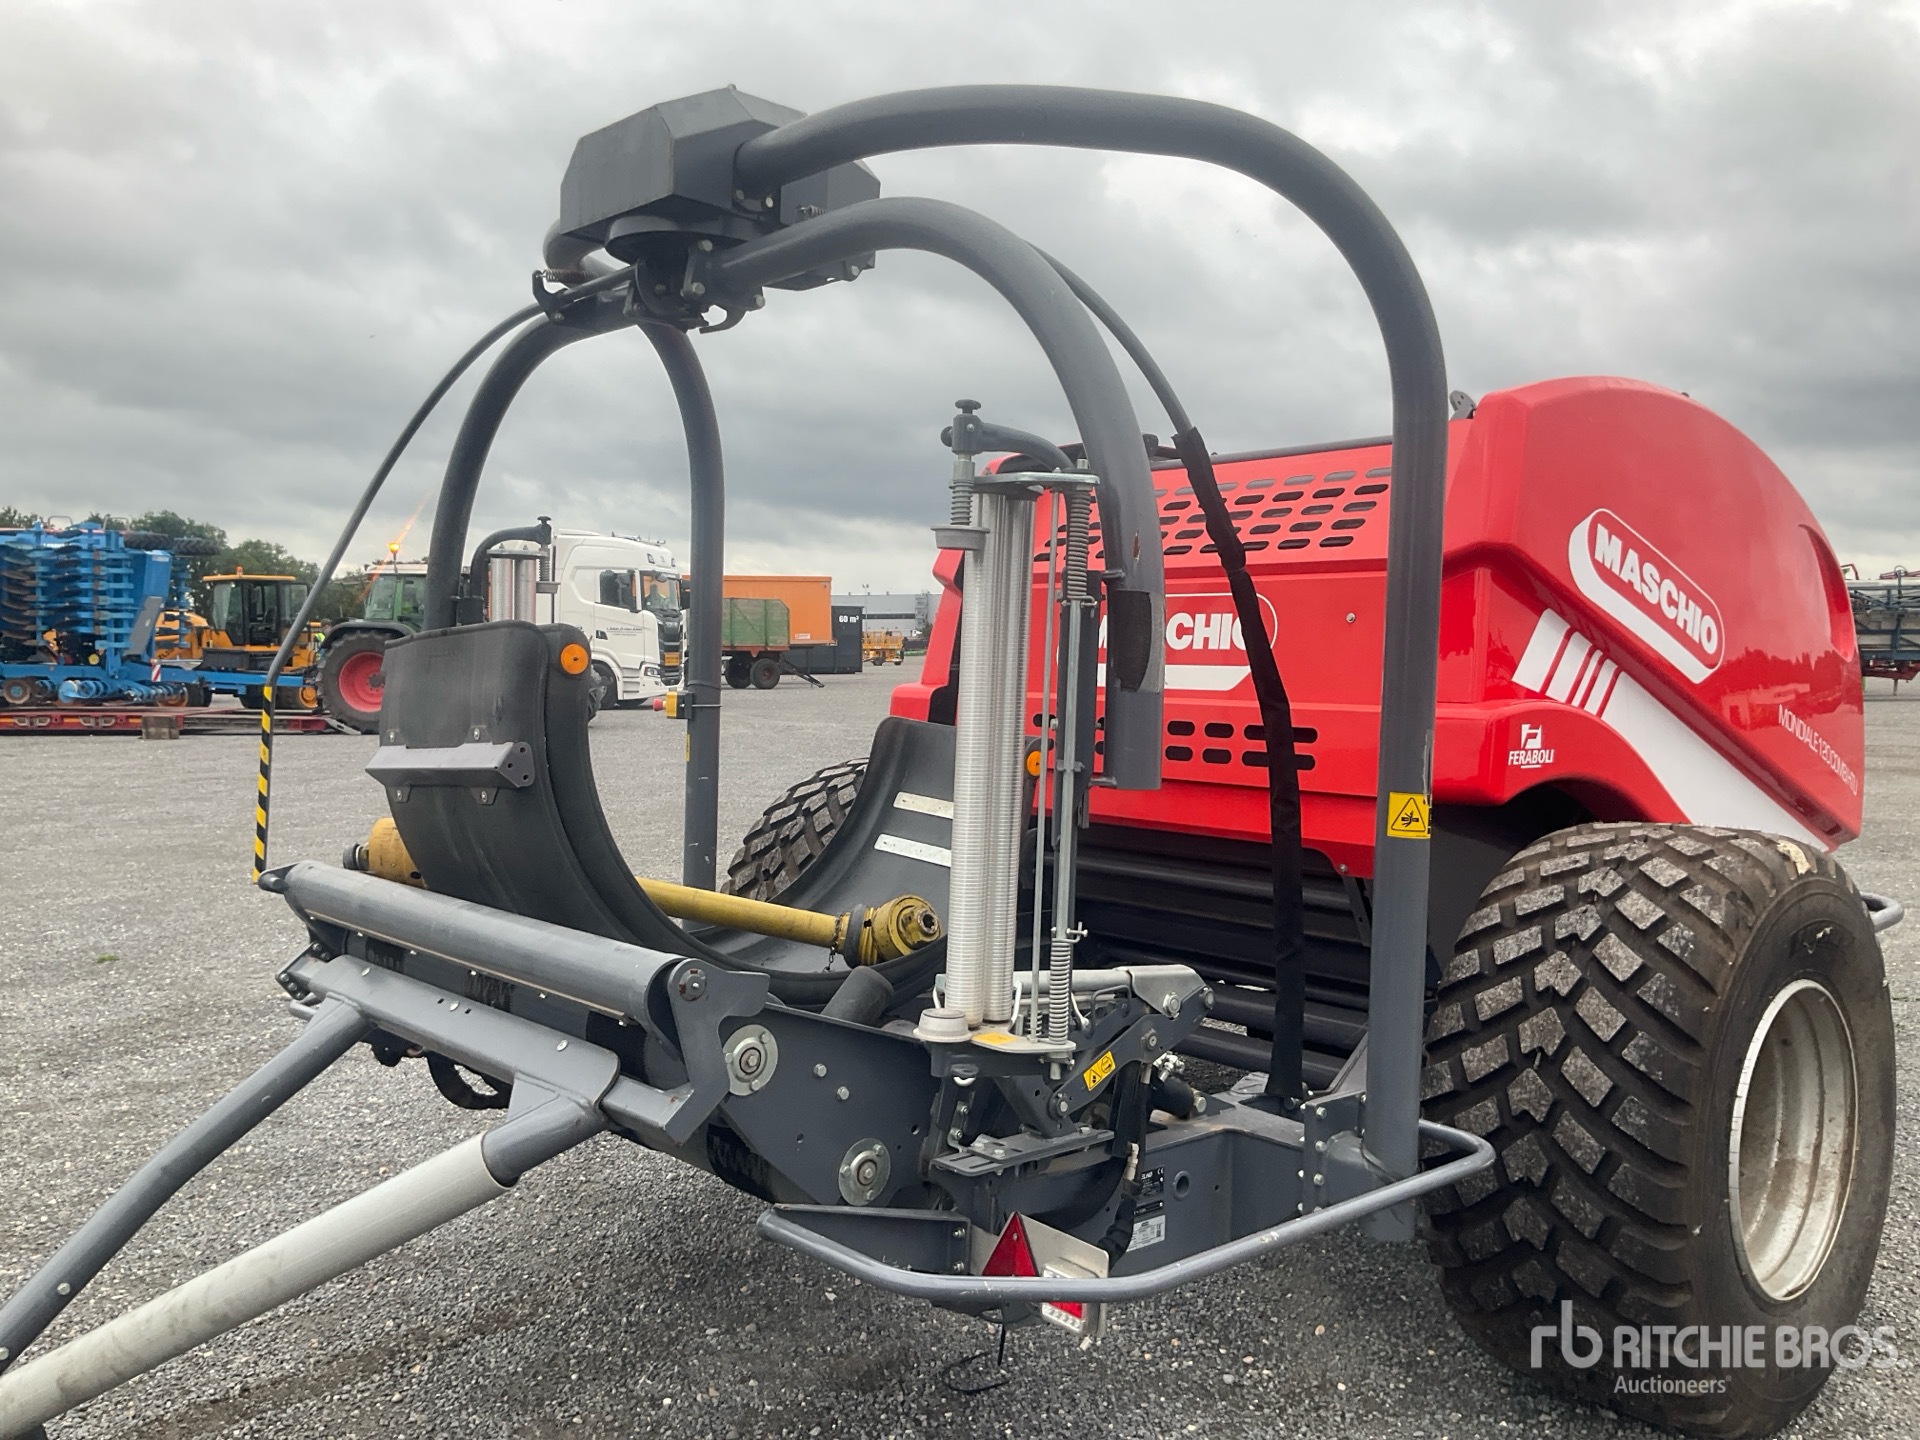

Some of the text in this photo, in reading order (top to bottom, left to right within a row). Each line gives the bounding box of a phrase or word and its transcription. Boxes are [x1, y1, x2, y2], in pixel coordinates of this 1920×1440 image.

[1594, 523, 1718, 655] MASCHIO
[838, 615, 848, 623] 60
[1778, 703, 1819, 753] MONDIALE
[1508, 749, 1555, 766] FERABOLI
